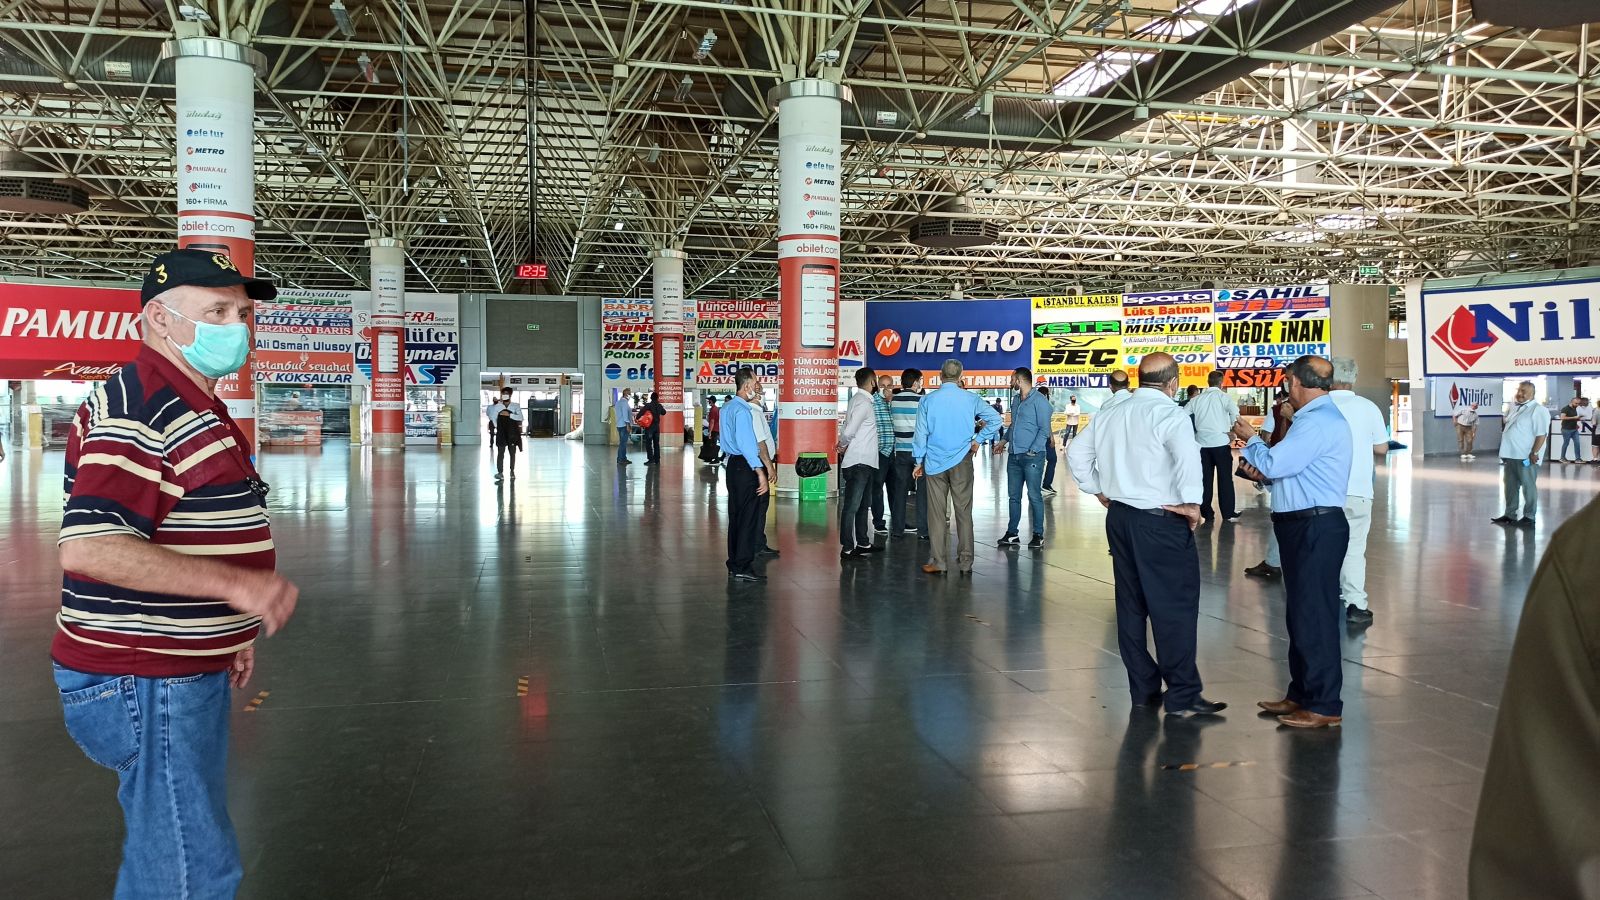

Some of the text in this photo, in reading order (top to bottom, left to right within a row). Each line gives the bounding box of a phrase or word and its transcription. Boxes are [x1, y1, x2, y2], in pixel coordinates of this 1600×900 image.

[182, 221, 235, 232] obilet.com
[156, 264, 168, 284] 3
[520, 266, 546, 276] 12:35
[1124, 306, 1210, 316] Lüks Batman
[1218, 310, 1320, 321] JET
[258, 316, 328, 326] MURAT
[1125, 316, 1198, 324] ardahan
[1468, 298, 1600, 344] Nil
[1047, 321, 1120, 333] STR
[1169, 322, 1212, 332] YOLU
[256, 340, 352, 352] Ali Osman Ulusoy
[700, 340, 762, 350] AKSEL
[907, 330, 1024, 353] METRO
[604, 350, 650, 358] Patnos
[1232, 344, 1327, 356] AS BAYBURT
[794, 356, 811, 366] TÜM
[1038, 349, 1118, 368] SEÇ
[276, 372, 352, 382] KÖKSALLAR
[1048, 374, 1087, 386] MERSİN
[794, 388, 829, 396] GÜVENLE
[1459, 388, 1494, 406] Nilüfer
